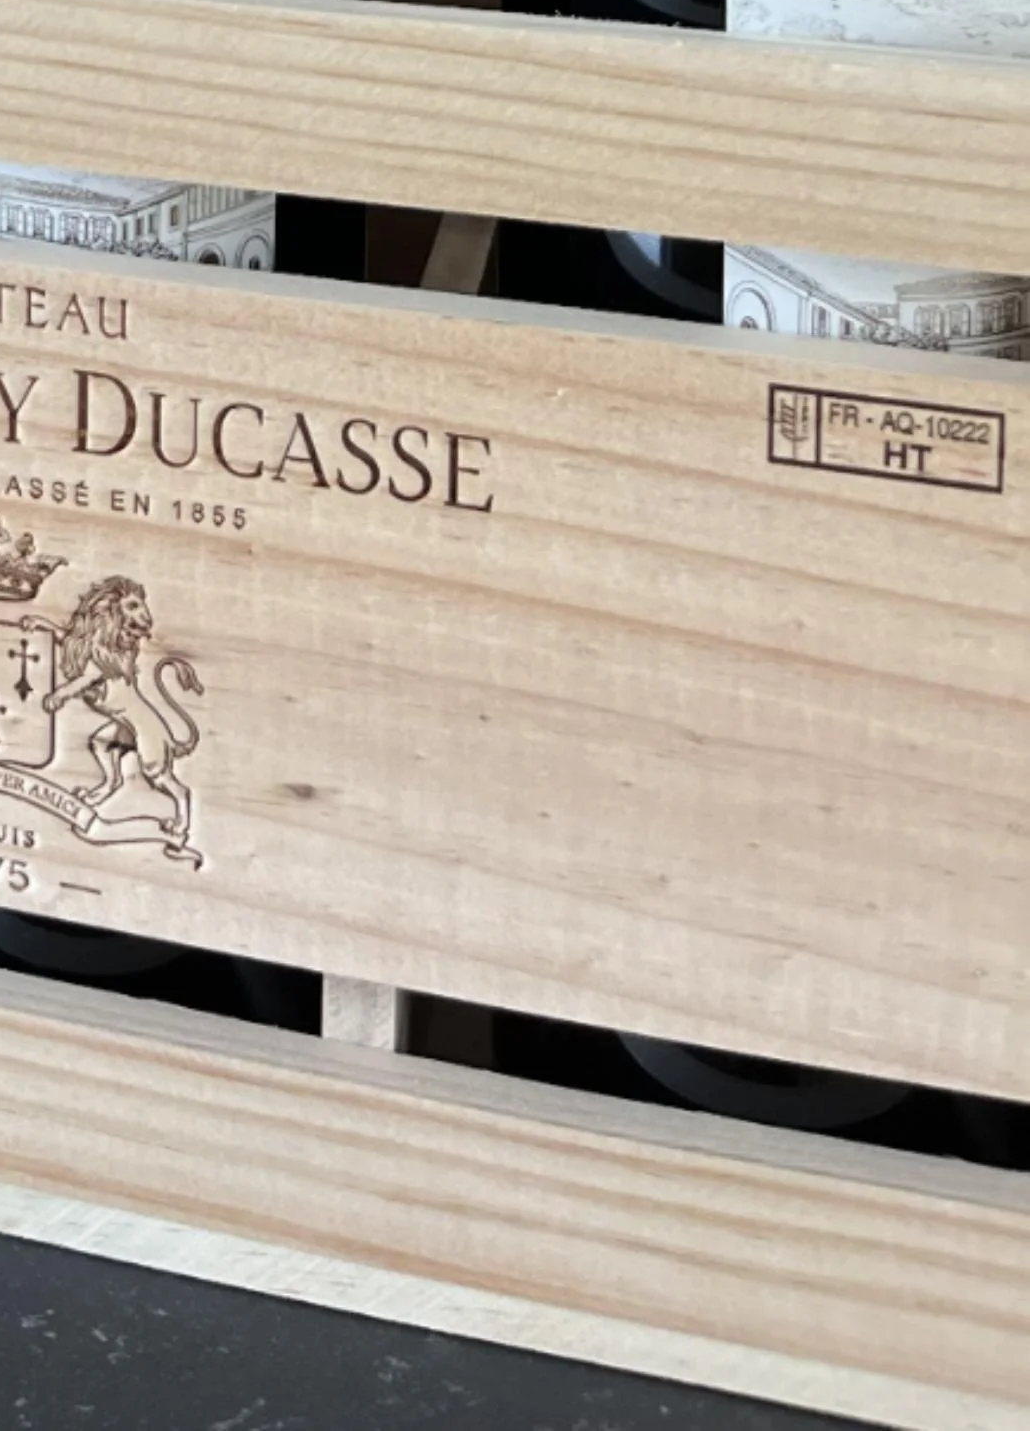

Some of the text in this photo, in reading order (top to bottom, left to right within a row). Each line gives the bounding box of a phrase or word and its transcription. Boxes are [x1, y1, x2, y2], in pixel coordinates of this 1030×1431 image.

[71, 368, 496, 514] DUCASSE
[828, 402, 860, 427] FR
[880, 410, 991, 445] AQ-10222
[883, 440, 933, 474] HT
[110, 489, 151, 516] EN
[171, 499, 248, 530] 1855
